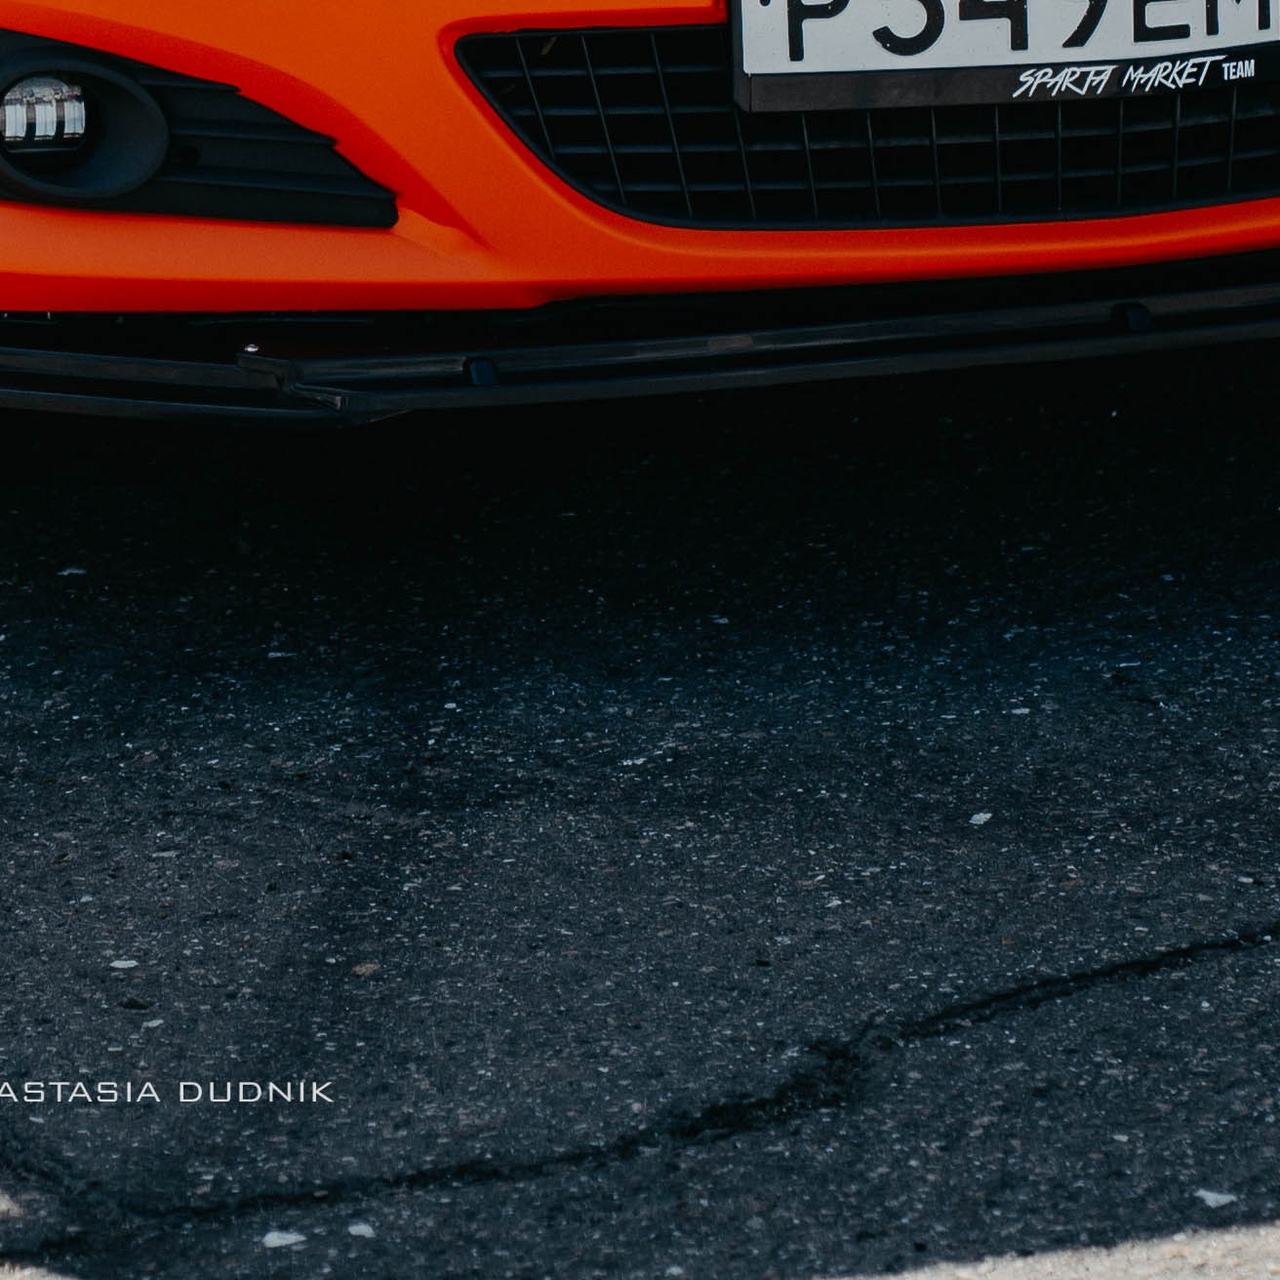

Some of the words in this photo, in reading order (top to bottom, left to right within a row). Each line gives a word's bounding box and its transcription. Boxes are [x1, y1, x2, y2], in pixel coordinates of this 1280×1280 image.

[1012, 64, 1119, 99] SPARTA
[1121, 54, 1229, 93] MARKET
[1222, 59, 1256, 81] TEAM
